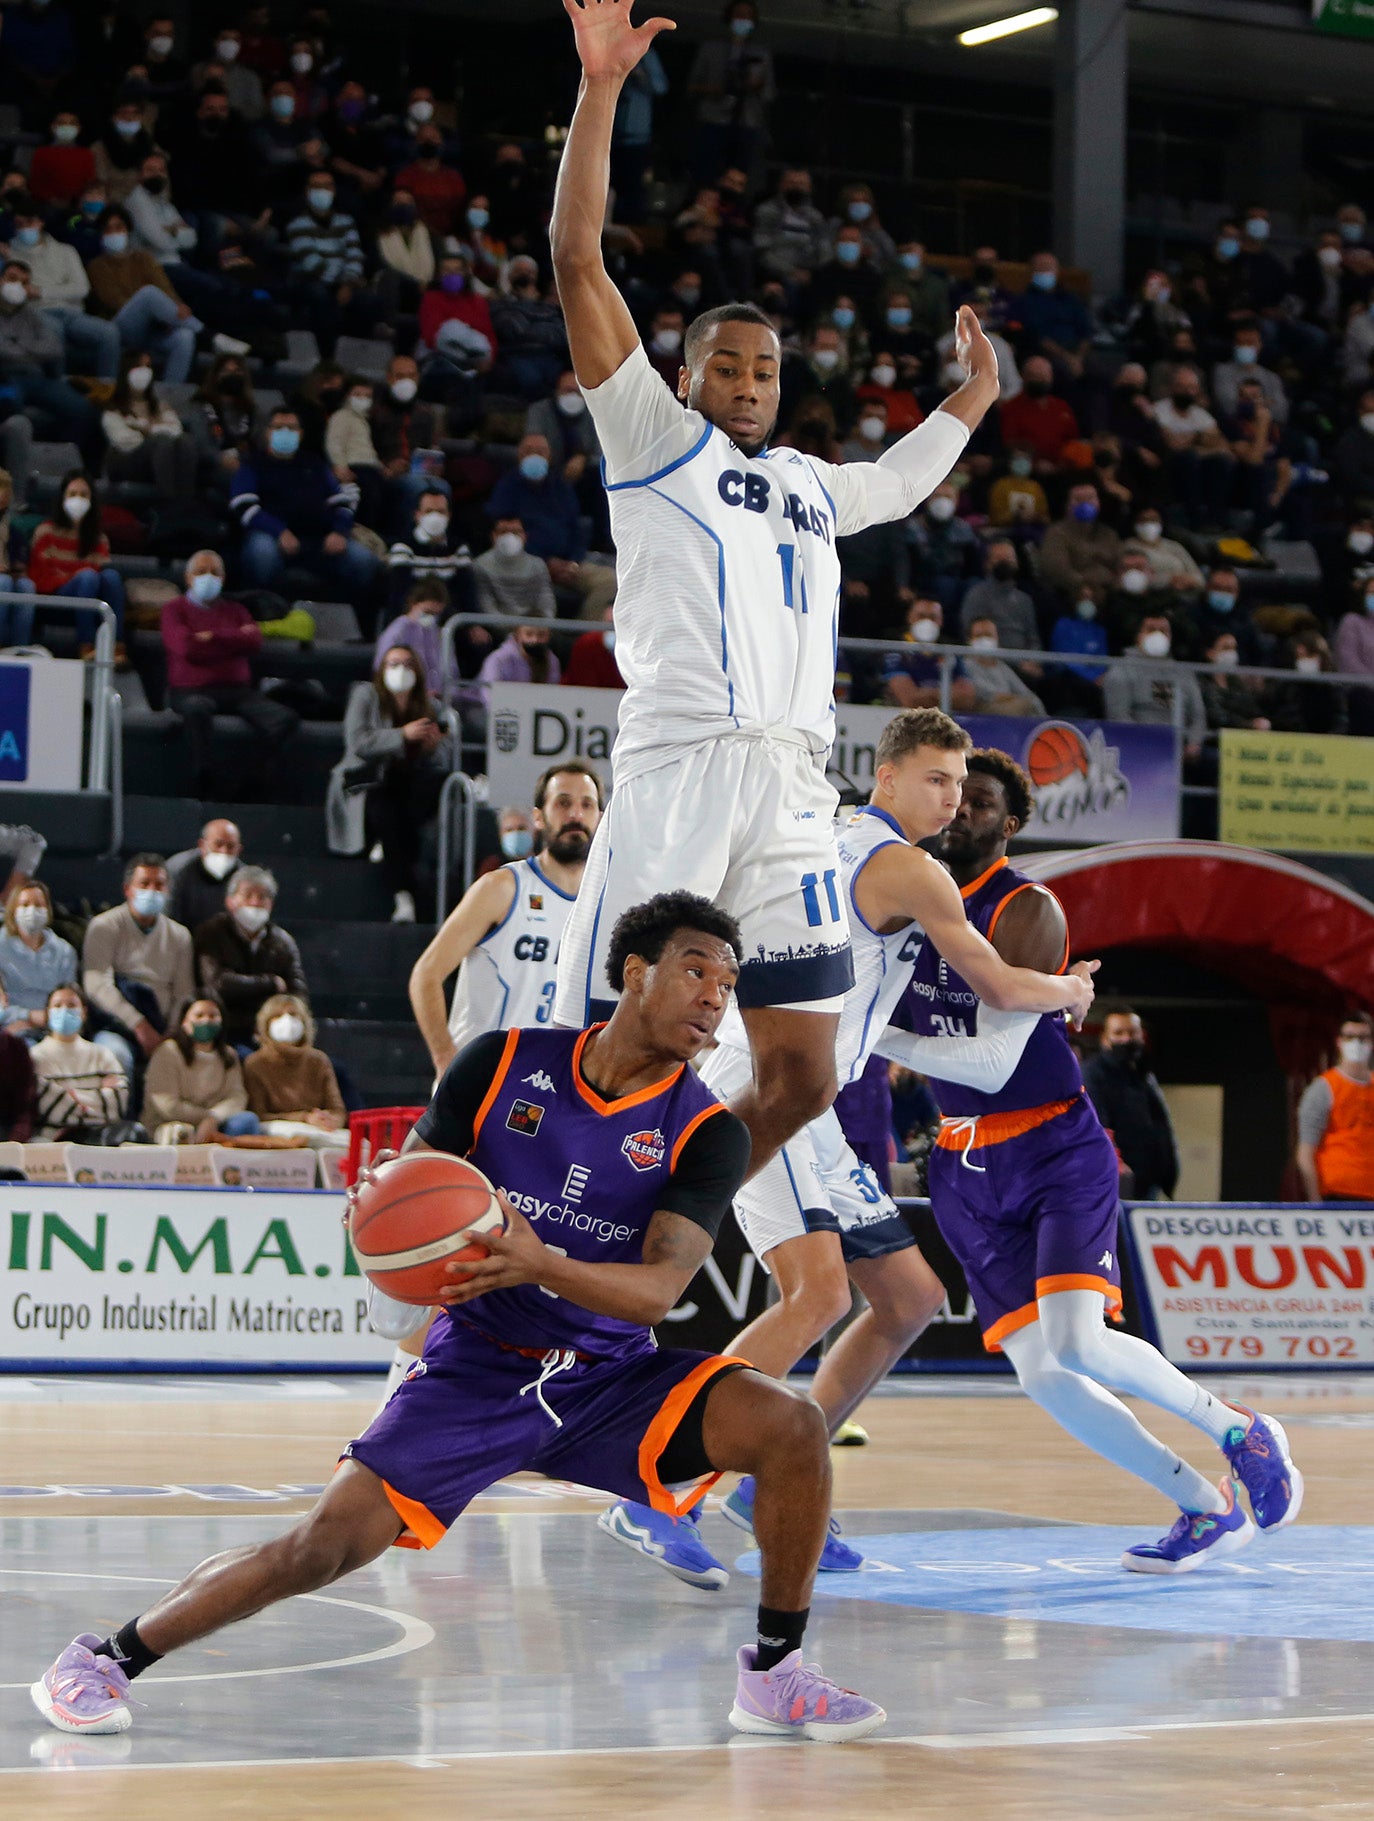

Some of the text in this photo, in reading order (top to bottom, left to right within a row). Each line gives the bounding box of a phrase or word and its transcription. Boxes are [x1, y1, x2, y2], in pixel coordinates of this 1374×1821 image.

[717, 469, 831, 547] CB RAT
[801, 868, 841, 928] 11
[514, 934, 549, 962] CB
[1145, 1216, 1284, 1236] DESGUACE
[1295, 1218, 1326, 1237] DE
[1151, 1244, 1374, 1290] MUN
[13, 1292, 91, 1340] Grupo
[103, 1292, 217, 1332] Industrial
[229, 1297, 343, 1333] Matricera
[1163, 1297, 1271, 1314] ASISTENCIA
[1274, 1297, 1328, 1314] GRUA
[1185, 1335, 1359, 1358] 979 702
